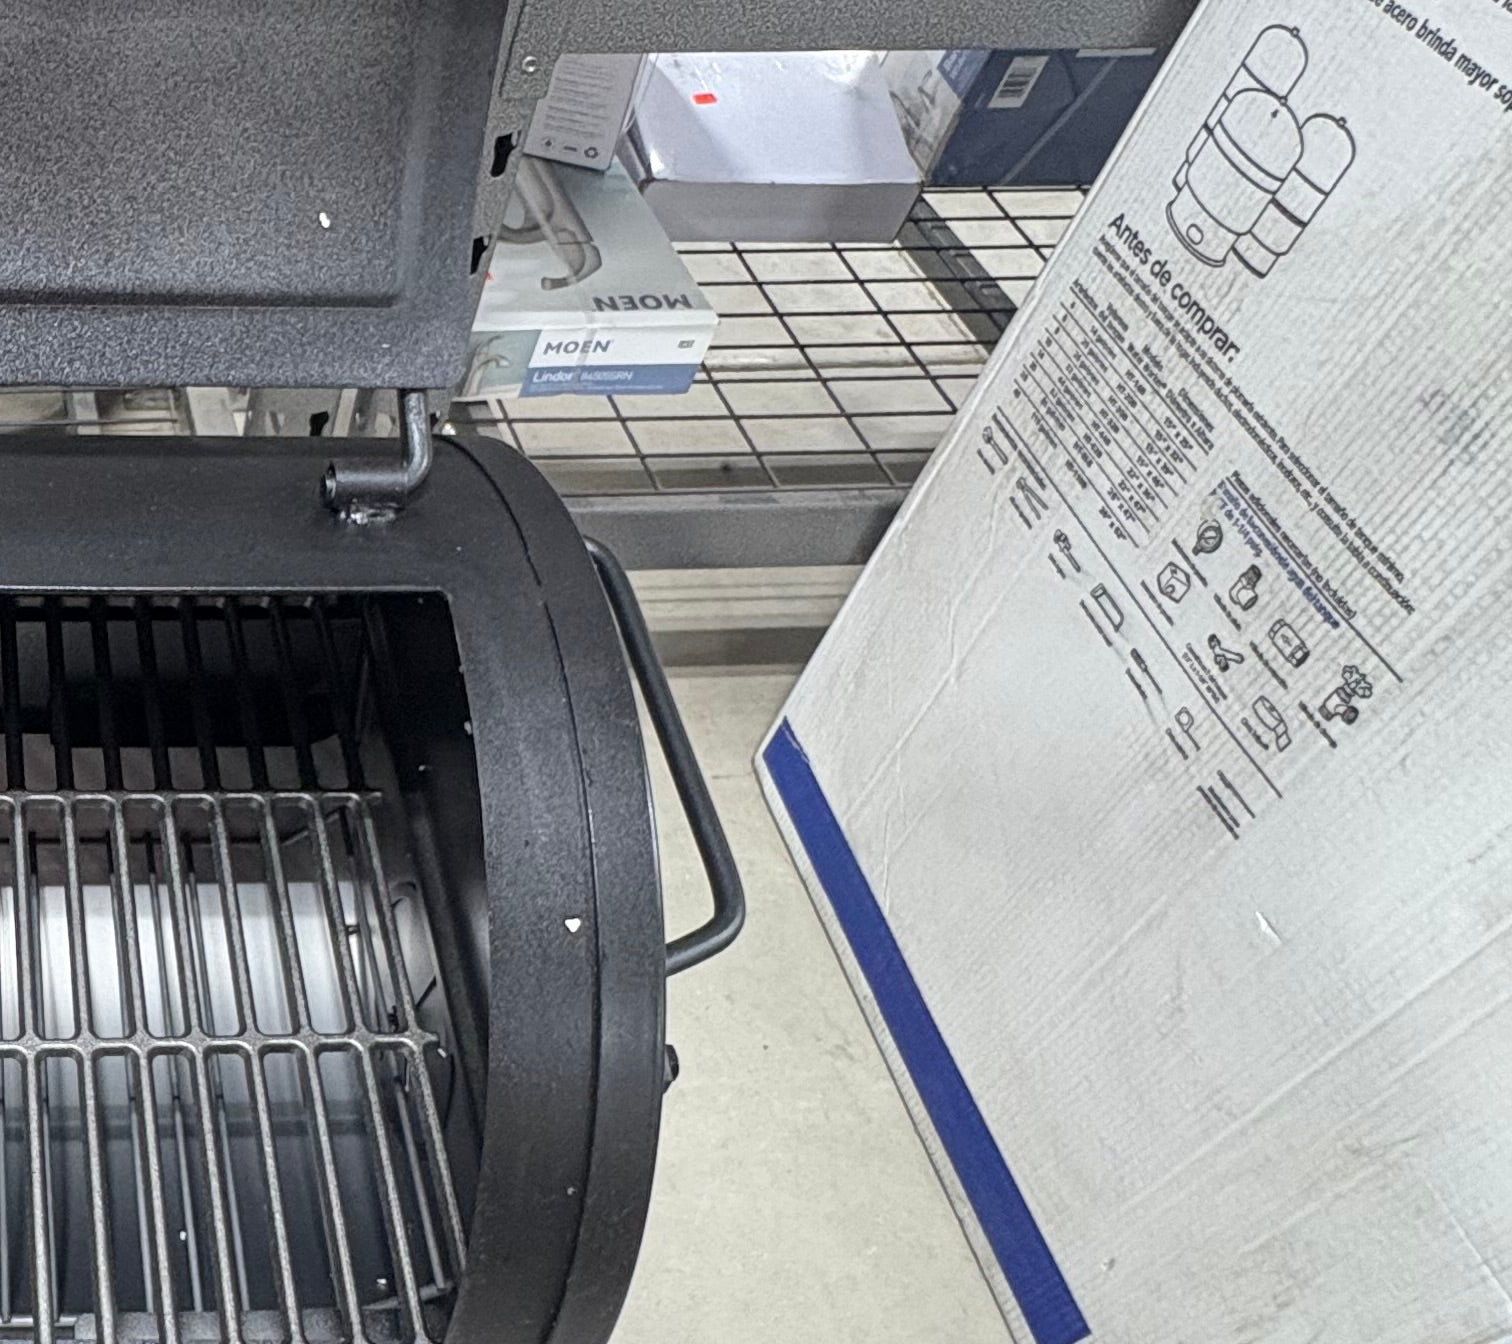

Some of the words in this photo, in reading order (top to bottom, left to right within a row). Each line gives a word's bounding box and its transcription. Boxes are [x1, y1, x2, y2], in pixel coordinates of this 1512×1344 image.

[1383, 0, 1418, 31] acero
[1415, 19, 1458, 62] brinda
[1454, 53, 1499, 91] mayor
[593, 293, 692, 312] MOEN
[1108, 213, 1152, 265] Antes
[1150, 260, 1172, 287] de
[1171, 283, 1240, 363] comprar:
[543, 340, 612, 355] MOEN
